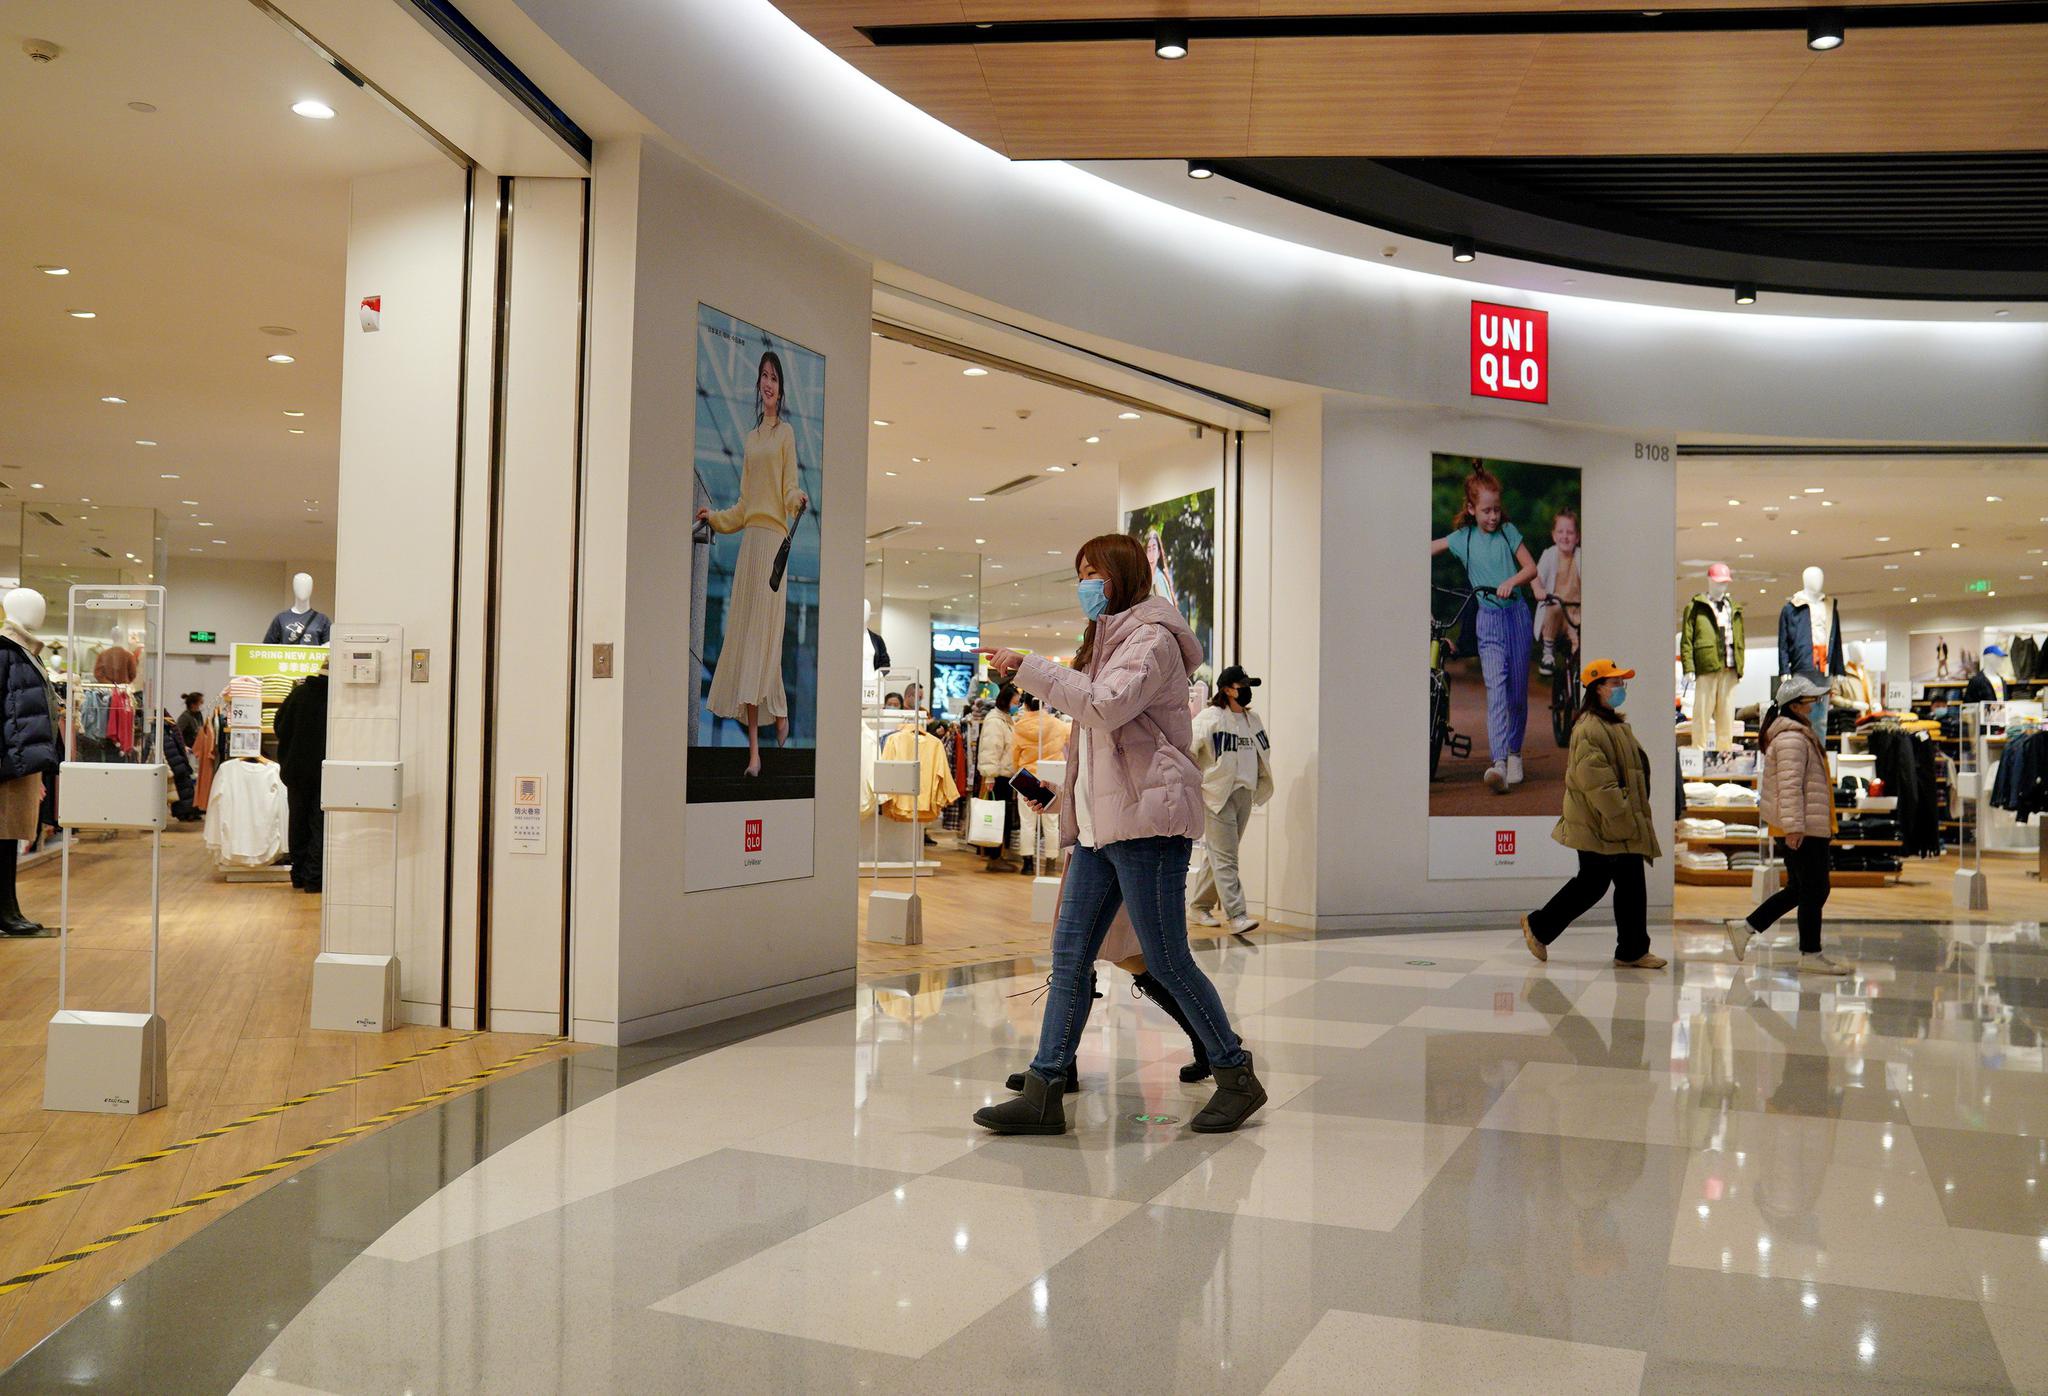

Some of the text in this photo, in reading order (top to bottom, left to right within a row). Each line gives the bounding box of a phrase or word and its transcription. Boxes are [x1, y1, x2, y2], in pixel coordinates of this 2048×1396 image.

[1480, 314, 1533, 353] UNI
[1480, 352, 1539, 392] QLO
[1635, 442, 1669, 462] B108
[249, 650, 283, 660] SPRING
[285, 651, 306, 661] NEW
[747, 823, 760, 835] UNI
[746, 836, 761, 850] QLO
[1497, 833, 1512, 843] UNI
[1497, 843, 1514, 854] QLO
